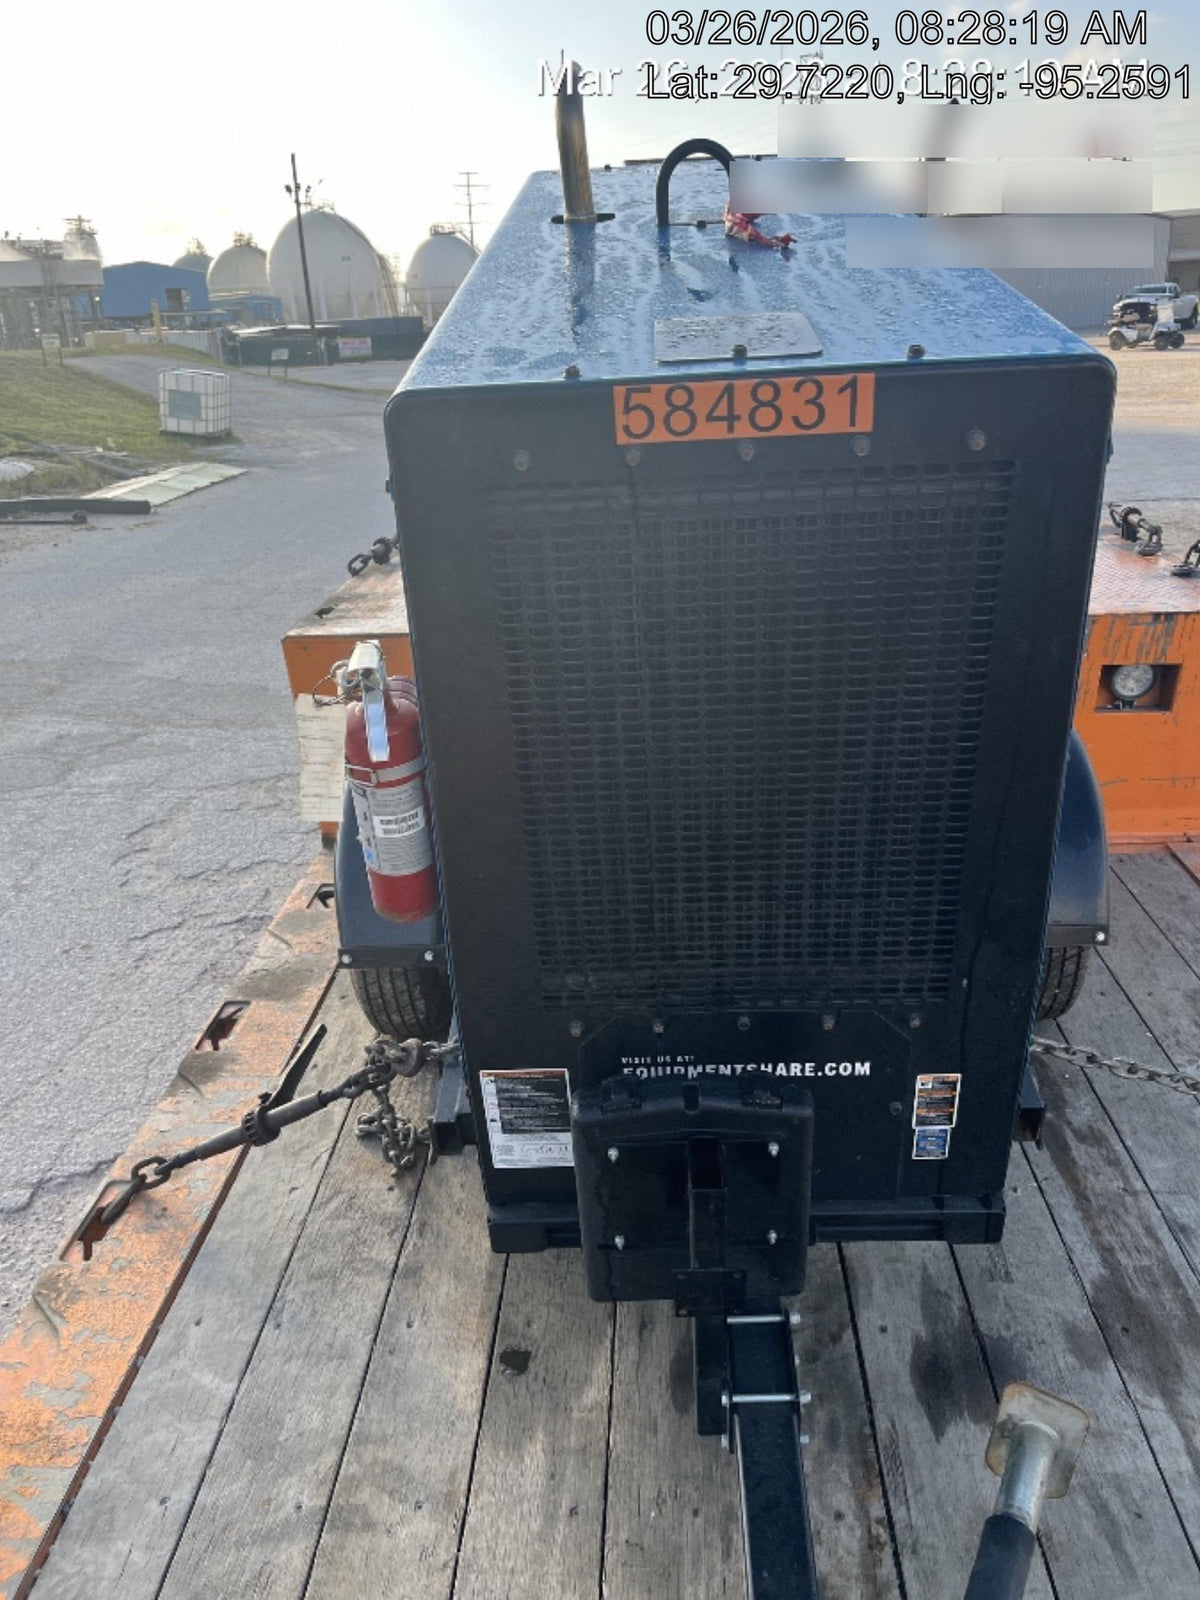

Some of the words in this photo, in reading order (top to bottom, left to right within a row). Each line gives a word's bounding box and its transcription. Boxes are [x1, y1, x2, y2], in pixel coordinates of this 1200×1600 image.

[621, 375, 859, 439] 584831
[621, 1056, 651, 1064] VISIT
[657, 1055, 671, 1063] US
